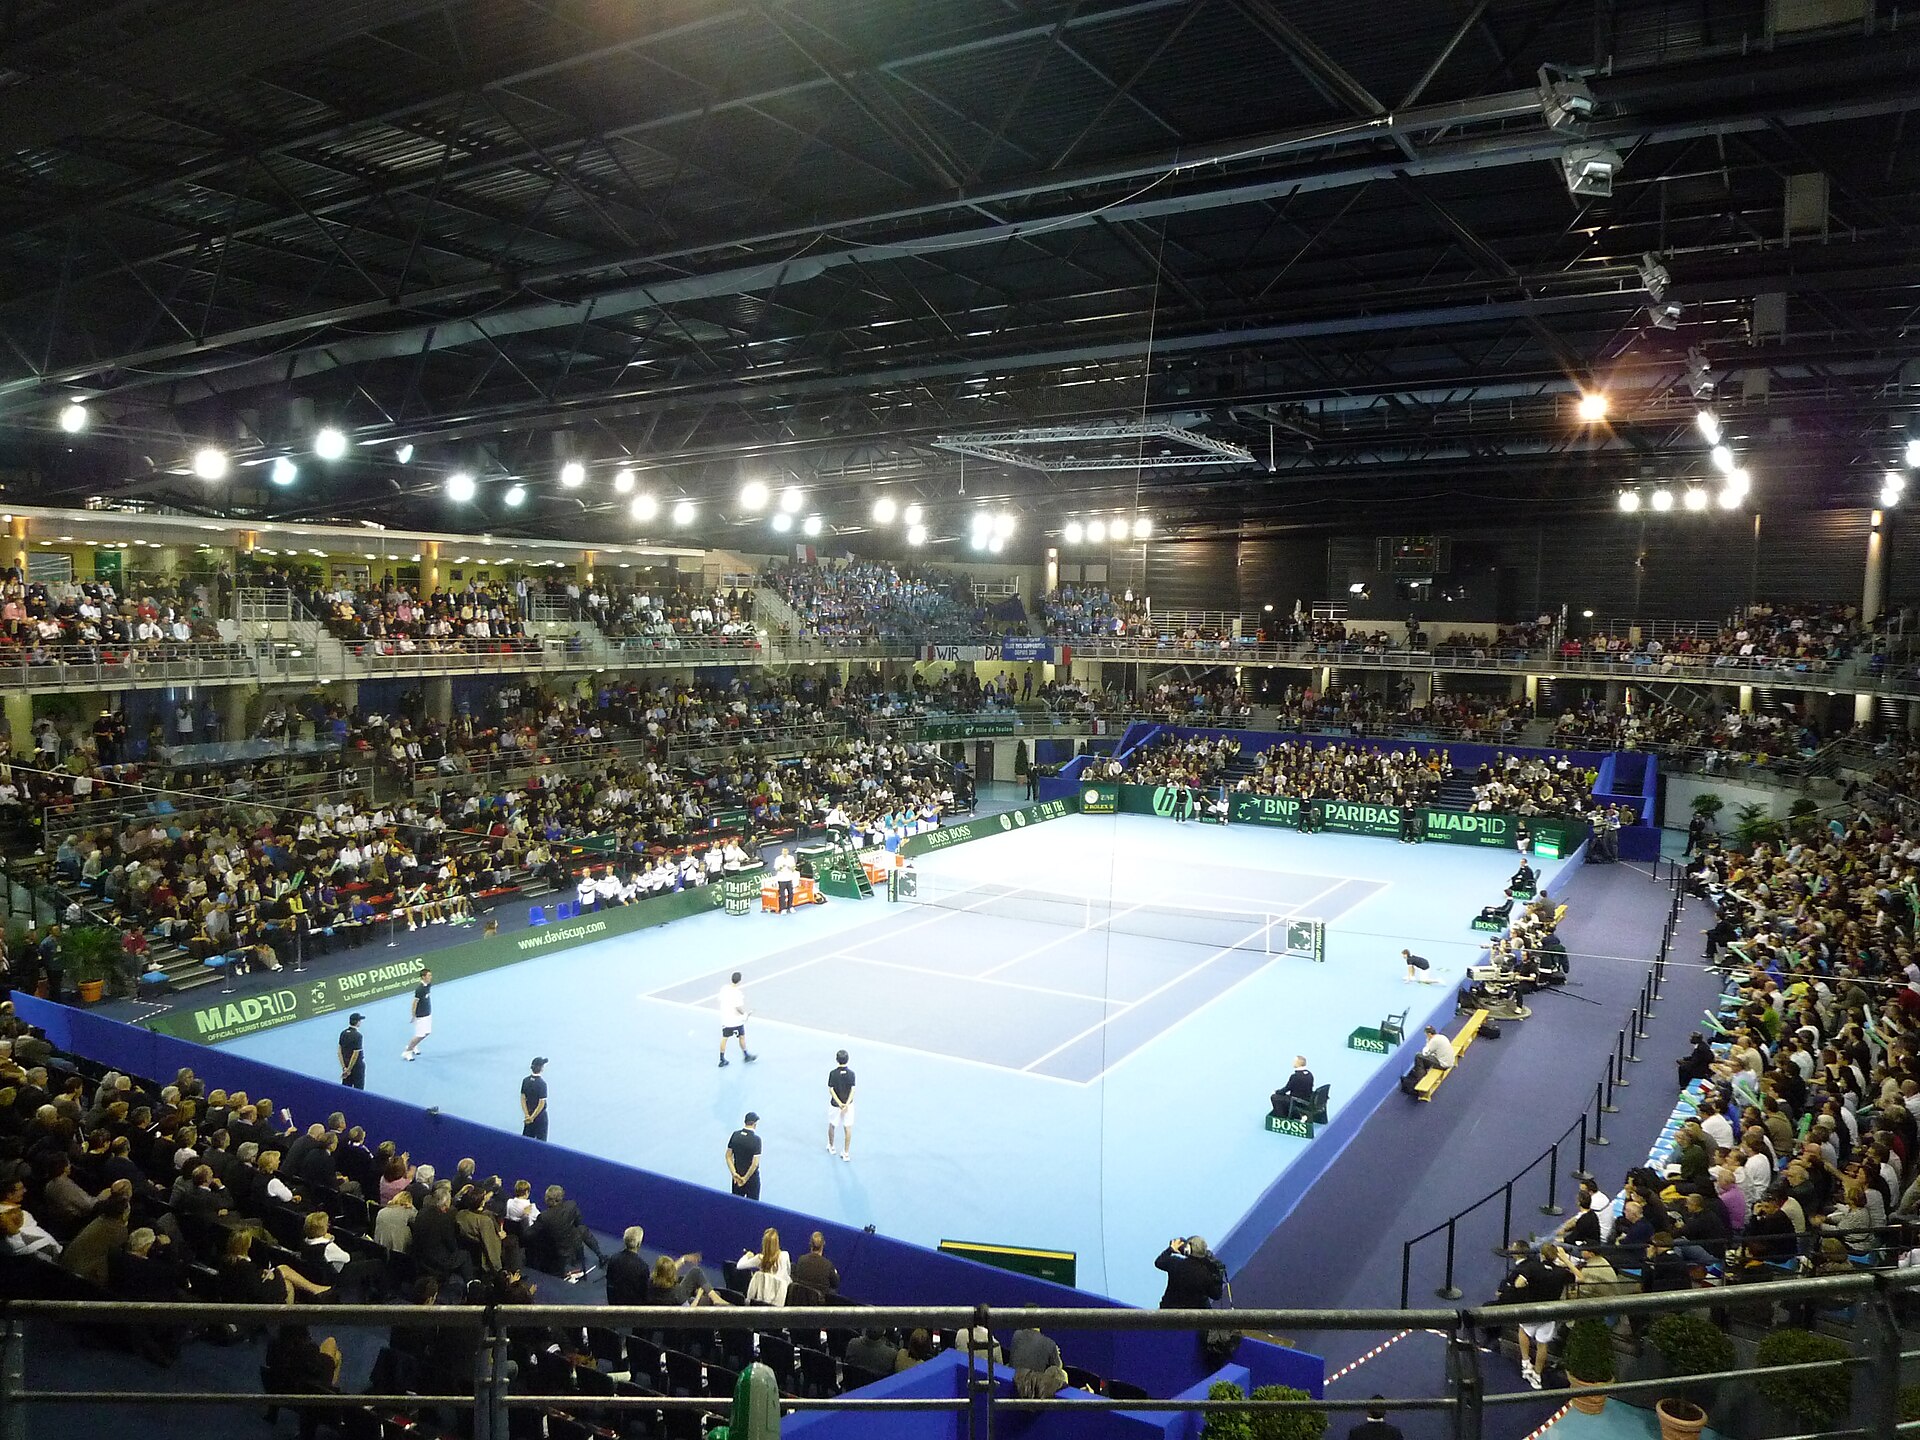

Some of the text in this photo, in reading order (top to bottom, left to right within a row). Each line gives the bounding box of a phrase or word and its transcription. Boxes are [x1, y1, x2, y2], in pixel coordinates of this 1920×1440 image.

[936, 646, 960, 660] WIR
[1264, 799, 1400, 825] BNP PARIBAS
[1428, 812, 1506, 834] MADRID
[927, 830, 950, 845] BOSS
[949, 825, 971, 839] BOSS
[518, 920, 607, 950] www.daviscup.com
[1475, 921, 1499, 930] BOSS
[338, 958, 426, 991] BNP PARIBAS
[194, 990, 297, 1034] MADRID
[208, 1014, 297, 1041] OFFICIAL TOURIST DESTINATION
[1353, 1037, 1385, 1051] BOSS
[1272, 1117, 1307, 1134] BOSS
